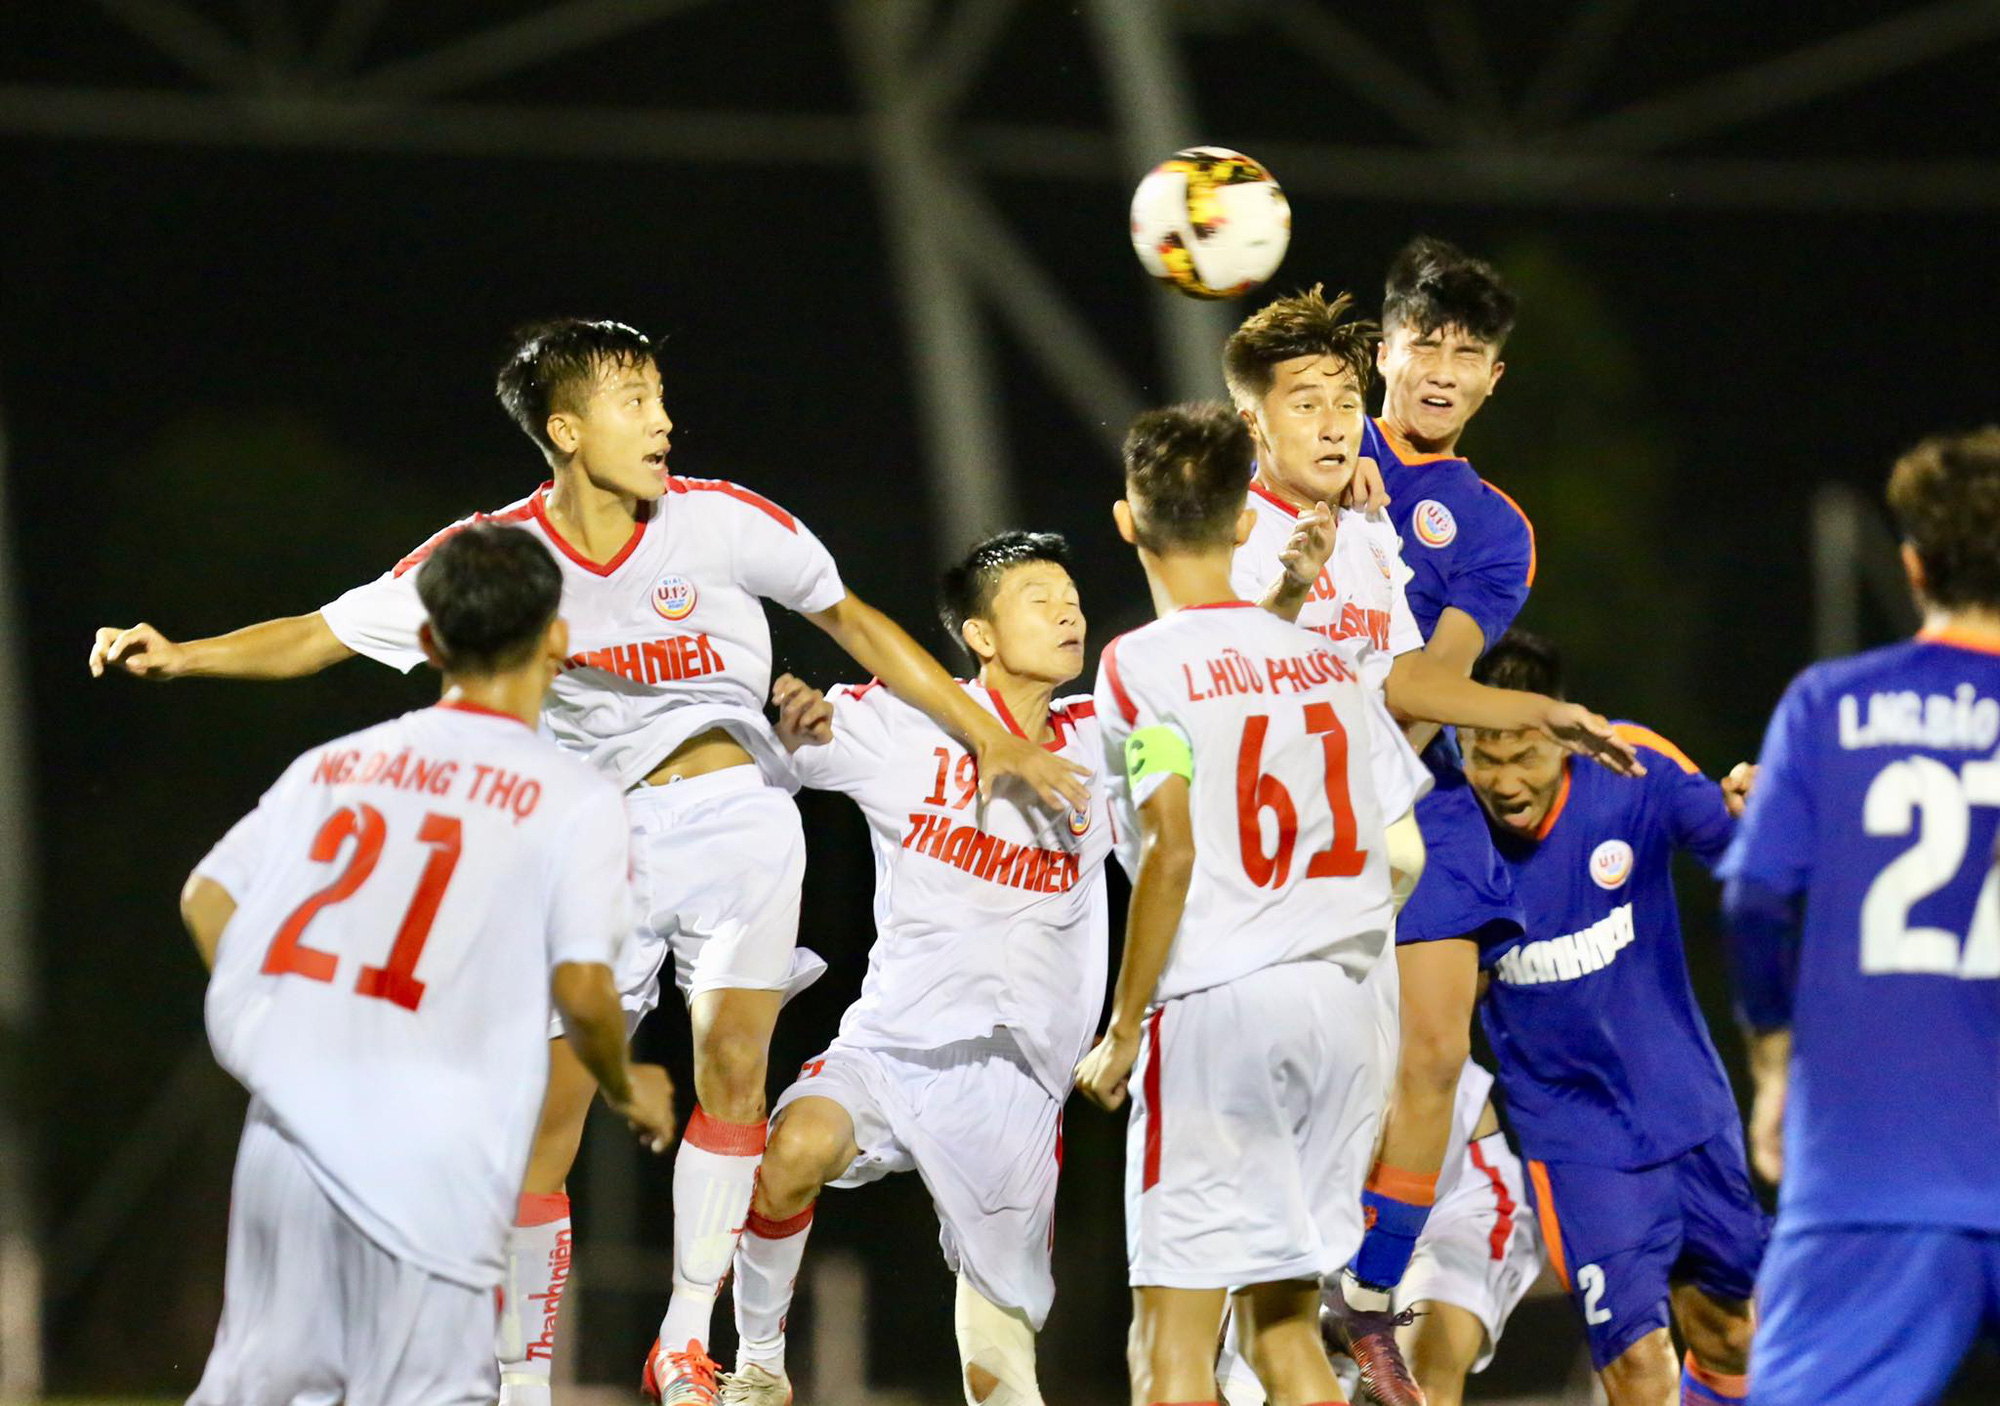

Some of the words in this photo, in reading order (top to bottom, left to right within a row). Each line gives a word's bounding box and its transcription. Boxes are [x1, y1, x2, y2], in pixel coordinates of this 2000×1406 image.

[923, 746, 978, 810] 19
[1236, 702, 1368, 890] 61
[260, 802, 462, 1013] 21
[1577, 1263, 1612, 1326] 2
